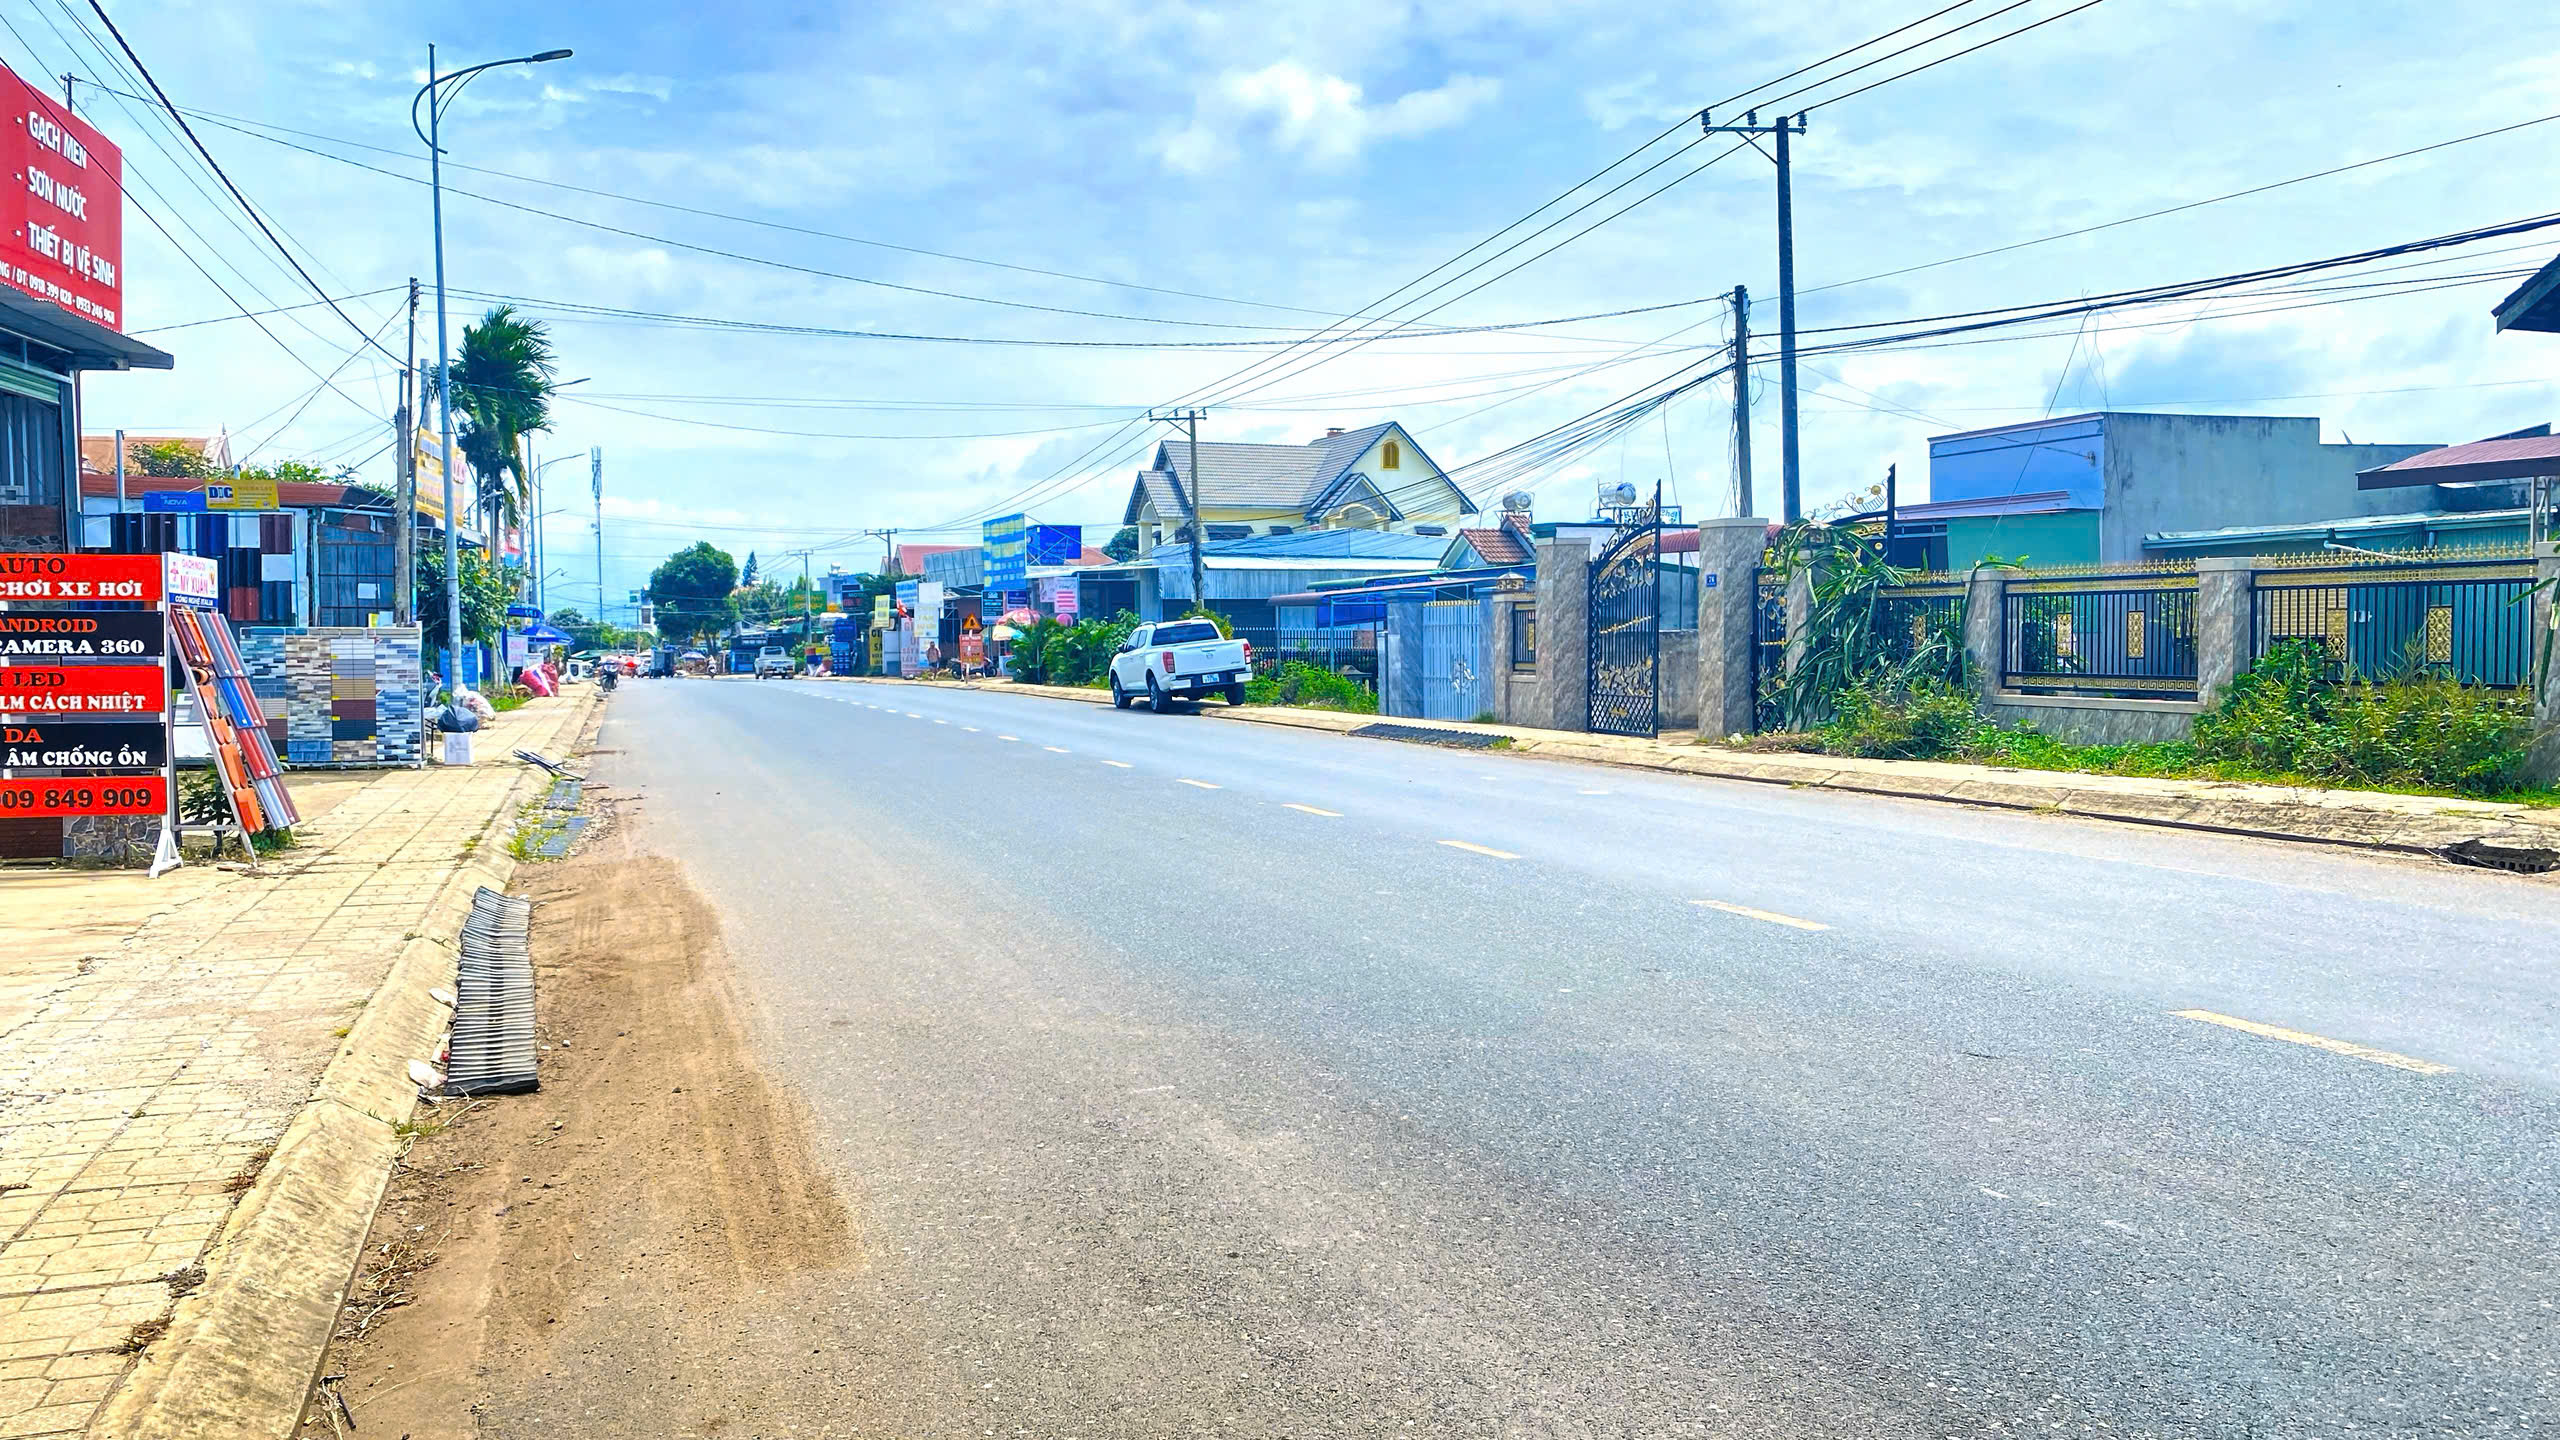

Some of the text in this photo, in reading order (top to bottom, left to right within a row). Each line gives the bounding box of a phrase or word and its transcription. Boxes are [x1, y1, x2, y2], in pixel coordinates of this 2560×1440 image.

[28, 111, 87, 170] GẠCH MEN
[27, 165, 87, 222] SƠN NƯỚC
[28, 221, 115, 288] THIẾT BỊ VỆ SINH
[46, 282, 59, 300] 399
[76, 296, 91, 314] 0933
[91, 302, 103, 320] 246
[208, 486, 233, 498] DIC
[57, 582, 92, 596] XE
[98, 579, 143, 596] HƠI
[100, 639, 145, 654] 360
[13, 672, 66, 687] LED
[29, 691, 82, 710] CÁCH
[87, 691, 146, 712] NHIỆT
[4, 728, 44, 743] DA
[5, 743, 147, 766] ÂM CHỐNG ỒN
[0, 788, 152, 809] 09 849 909
